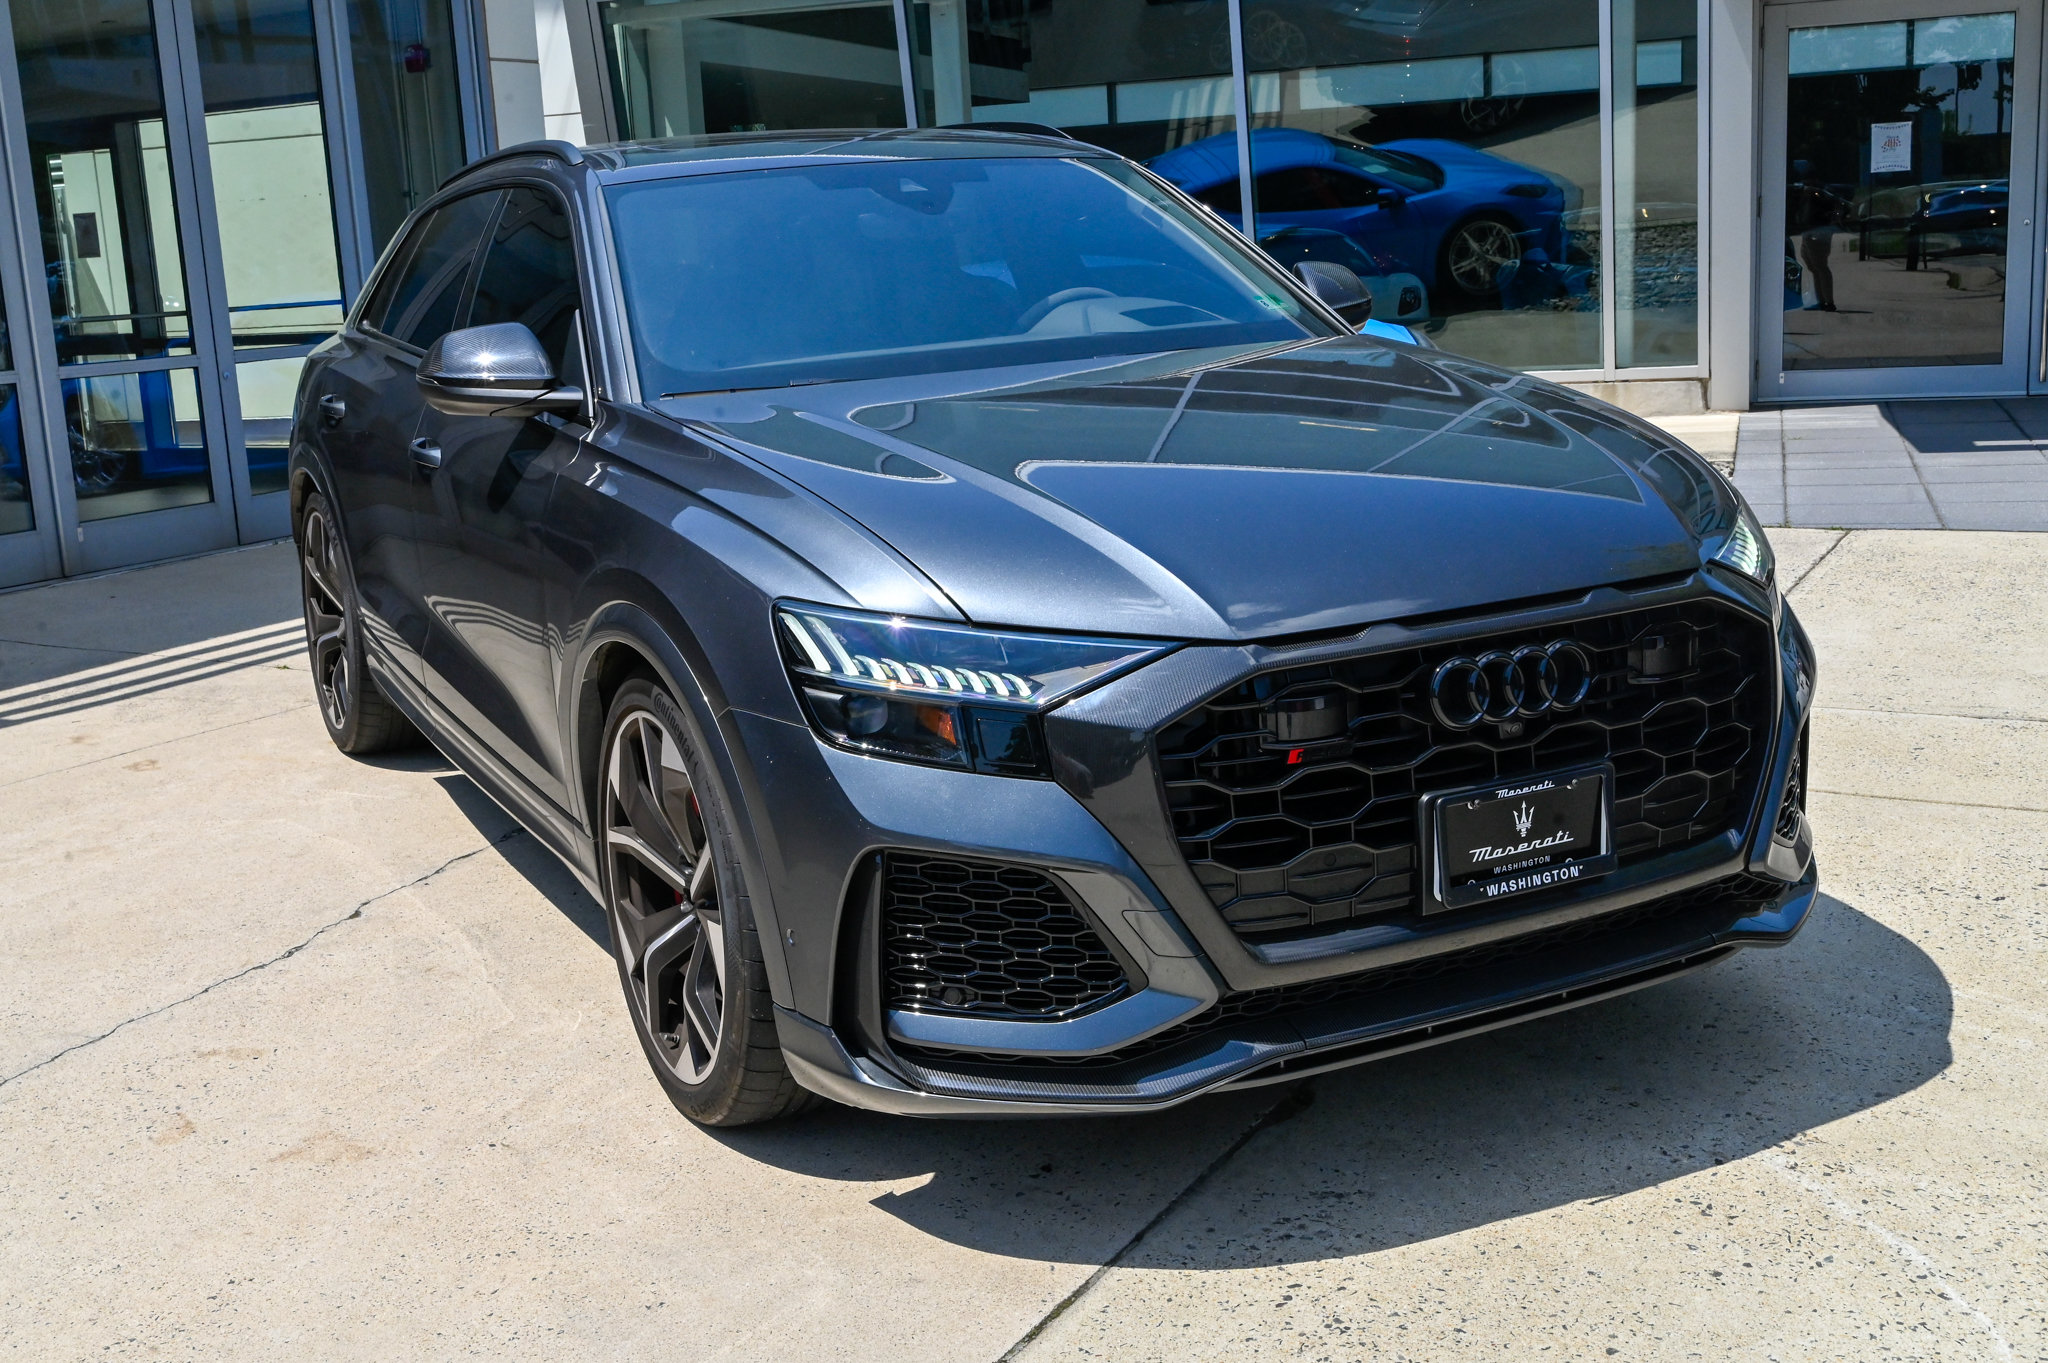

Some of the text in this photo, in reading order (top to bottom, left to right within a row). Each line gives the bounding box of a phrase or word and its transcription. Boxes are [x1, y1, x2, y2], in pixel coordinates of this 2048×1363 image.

[654, 693, 695, 762] Continental
[1495, 780, 1555, 799] Maserati
[1468, 830, 1574, 863] Maserati
[1486, 865, 1579, 897] WASHINGTON
[1493, 855, 1551, 875] WASHINGTON
